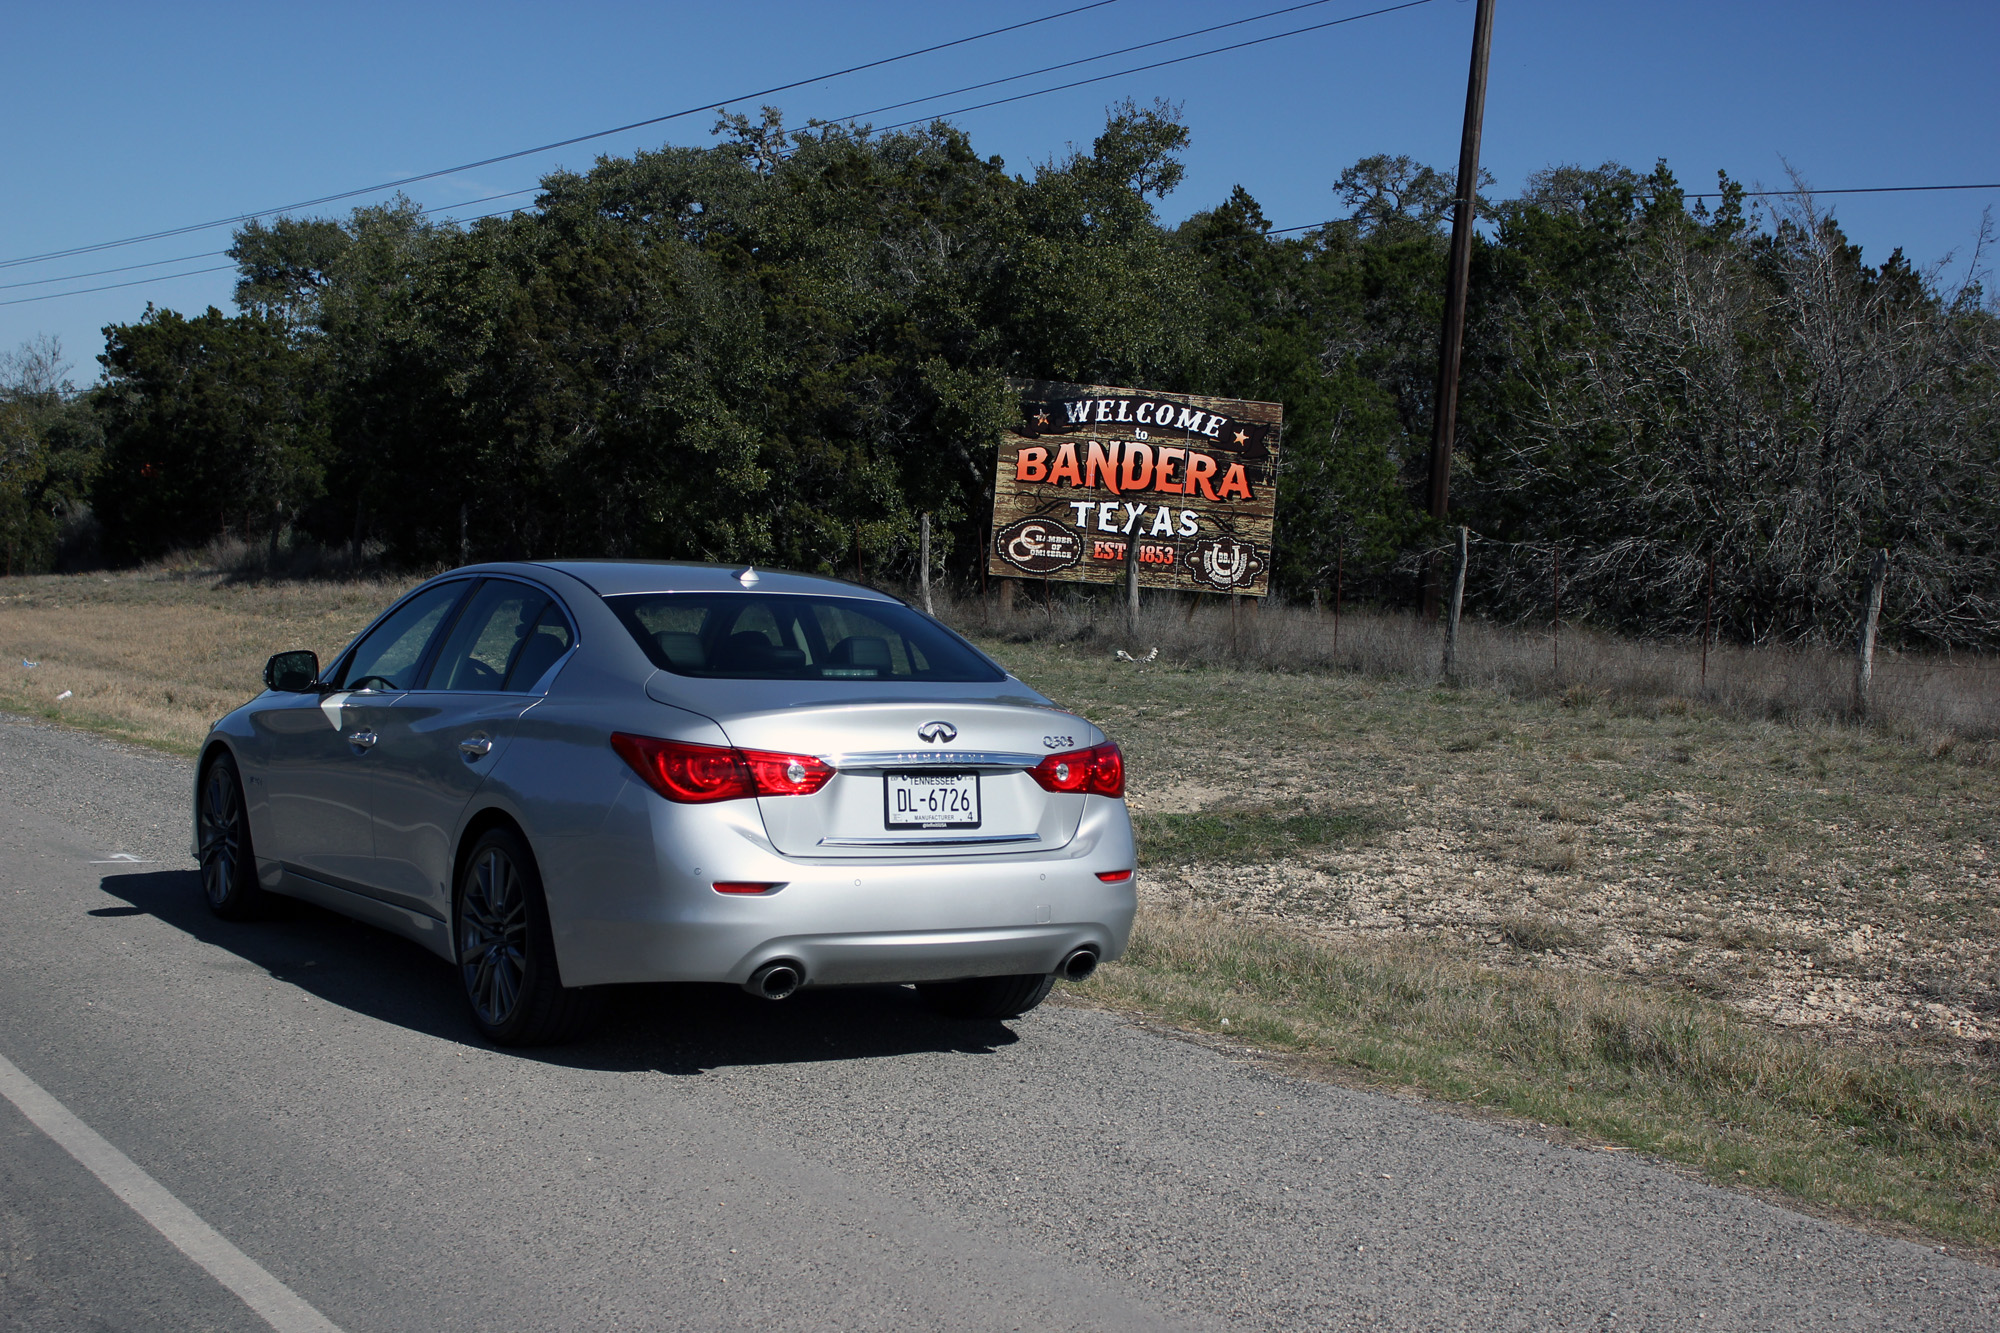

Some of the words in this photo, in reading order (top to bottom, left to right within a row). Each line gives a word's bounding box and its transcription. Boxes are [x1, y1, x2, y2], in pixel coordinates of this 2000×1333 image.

[1064, 399, 1228, 438] WELCOME
[1134, 427, 1148, 440] to
[1015, 440, 1253, 502] BANDERA
[1070, 500, 1200, 537] TEXAS
[1093, 541, 1127, 561] EST
[1139, 545, 1174, 565] 1853
[1042, 735, 1075, 749] Q50S
[910, 776, 955, 785] TENNESSEE
[897, 788, 970, 812] DL-6726
